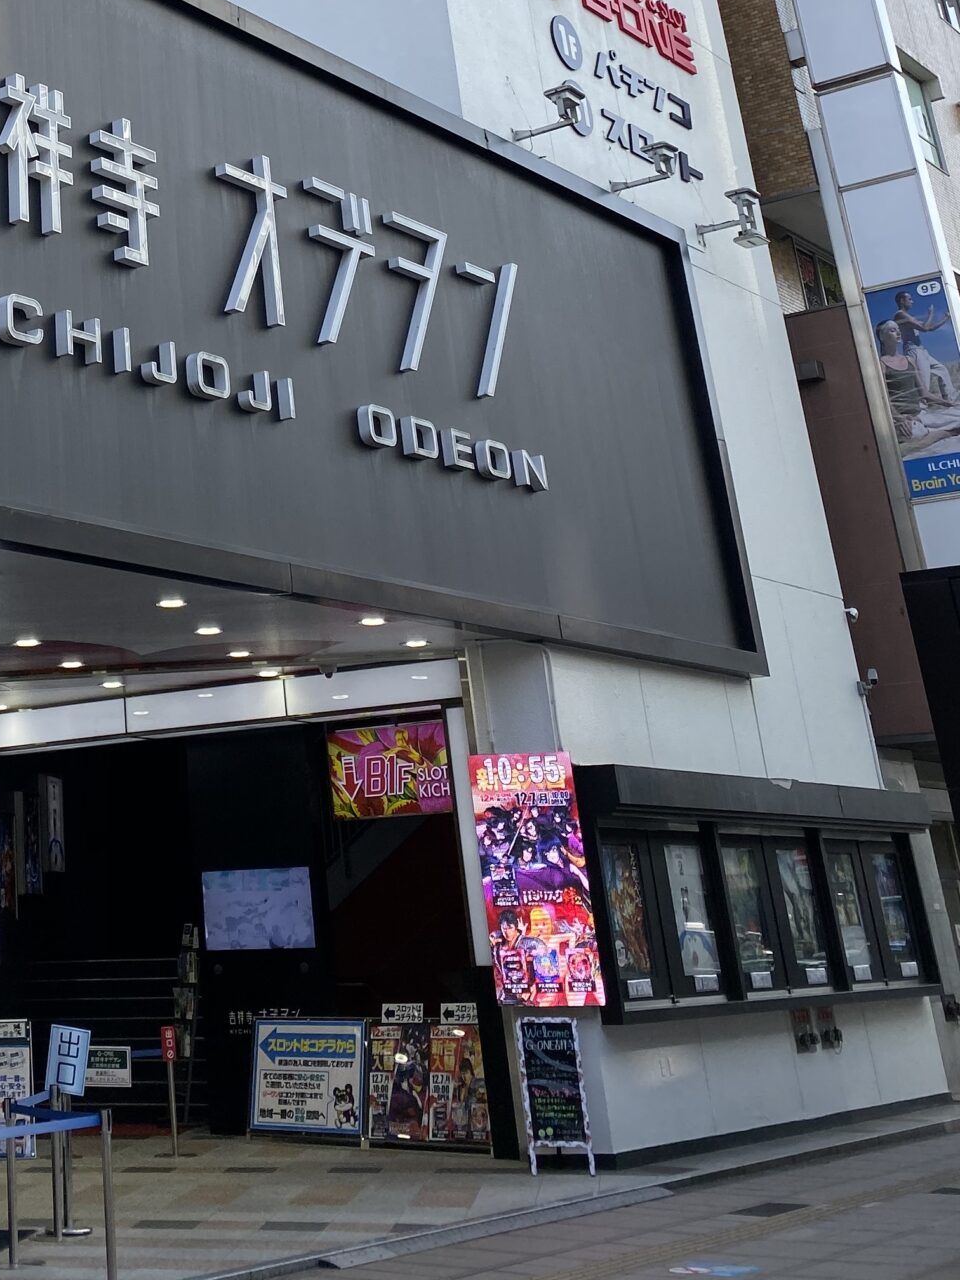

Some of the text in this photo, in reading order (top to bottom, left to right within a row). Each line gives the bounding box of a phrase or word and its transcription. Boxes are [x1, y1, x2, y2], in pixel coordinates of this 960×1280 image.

[655, 0, 688, 33] SLOT
[594, 50, 693, 129] パチンコ
[601, 108, 704, 183] スロト
[215, 155, 519, 399] オデヲン
[920, 282, 938, 295] 9F
[357, 403, 549, 492] ODEON
[912, 474, 947, 492] Brain
[365, 754, 415, 798] B1F
[417, 765, 449, 781] SLOT
[483, 755, 561, 785] 10:55
[228, 1010, 253, 1025] 吉祥寺
[57, 1031, 81, 1086] 出口
[267, 1038, 355, 1054] スロットはコチラから
